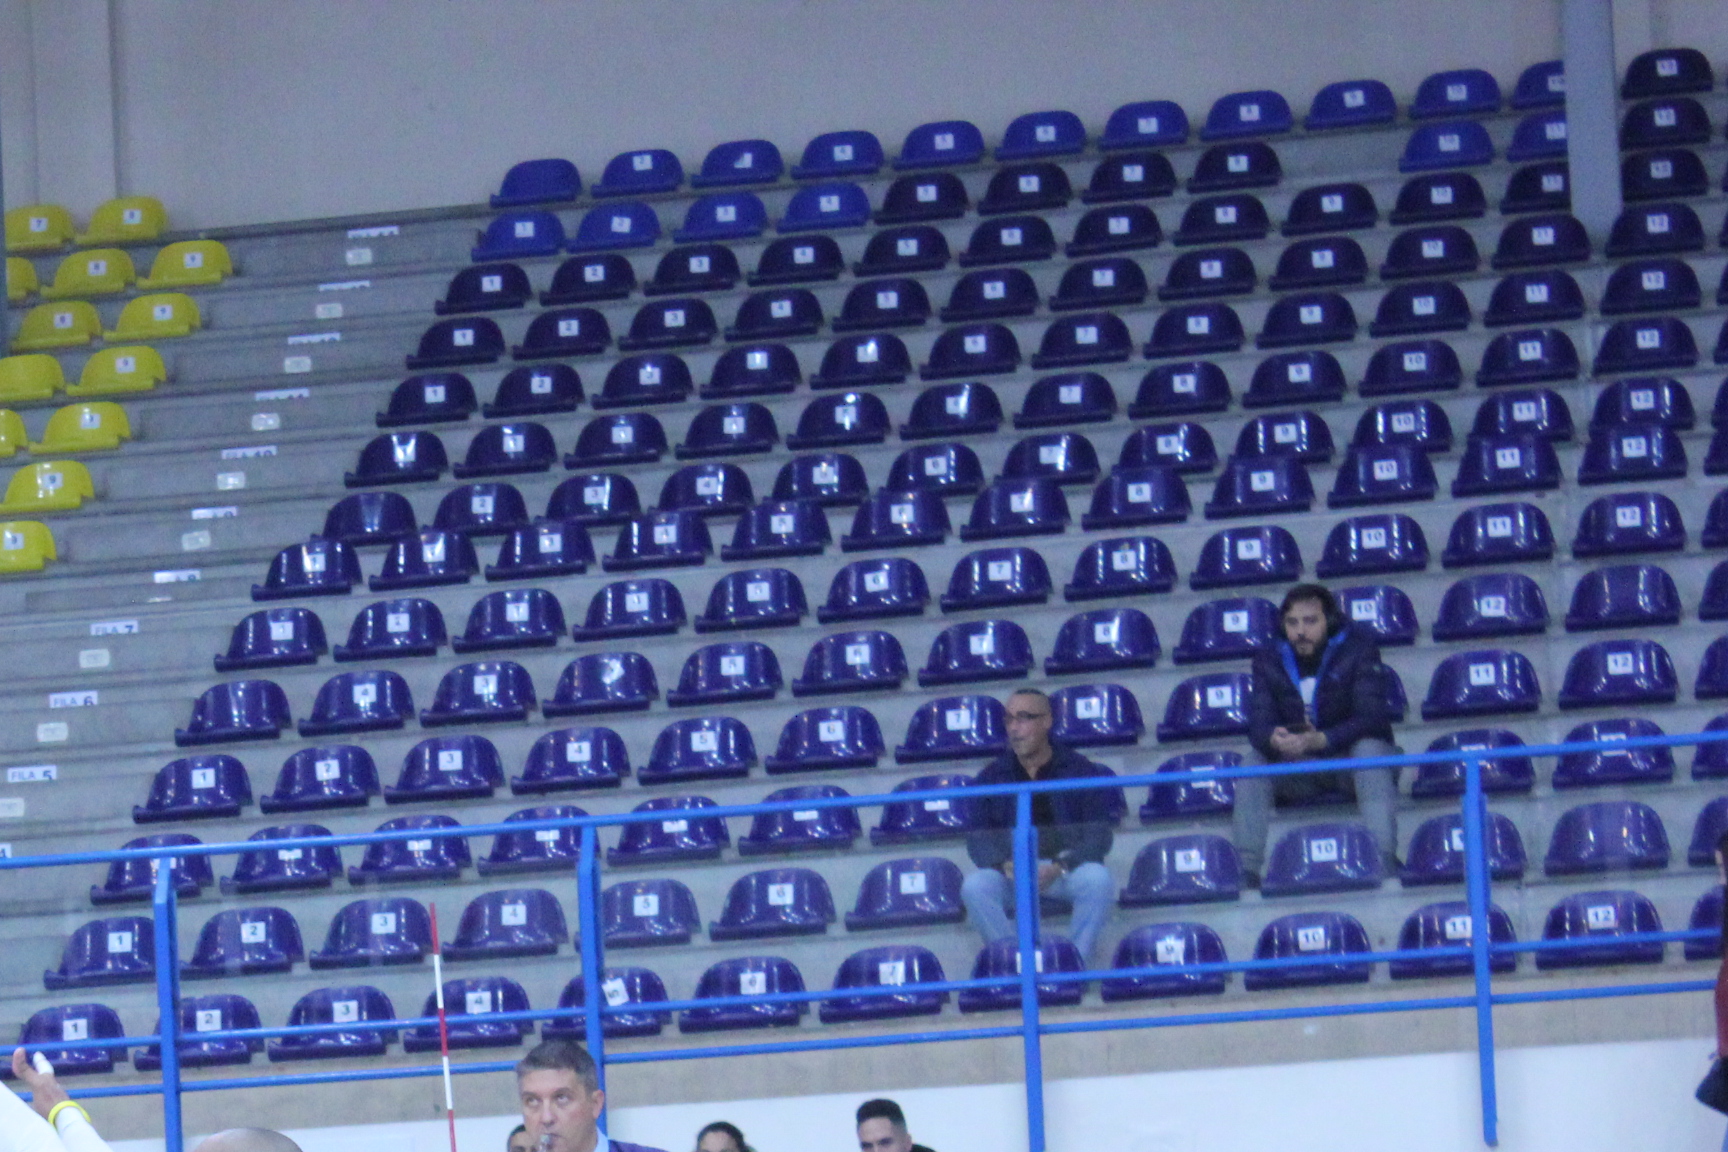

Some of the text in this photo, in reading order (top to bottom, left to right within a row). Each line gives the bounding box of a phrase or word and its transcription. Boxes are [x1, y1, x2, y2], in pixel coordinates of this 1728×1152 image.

[1501, 451, 1516, 462] 11
[1378, 462, 1394, 474] 10
[1492, 520, 1507, 531] 11
[1366, 530, 1383, 542] 10
[1612, 656, 1629, 668] 12
[1474, 667, 1490, 678] 11
[10, 769, 36, 781] FILA
[1315, 842, 1334, 854] 10
[1592, 909, 1611, 922] 12
[1450, 919, 1467, 932] 11
